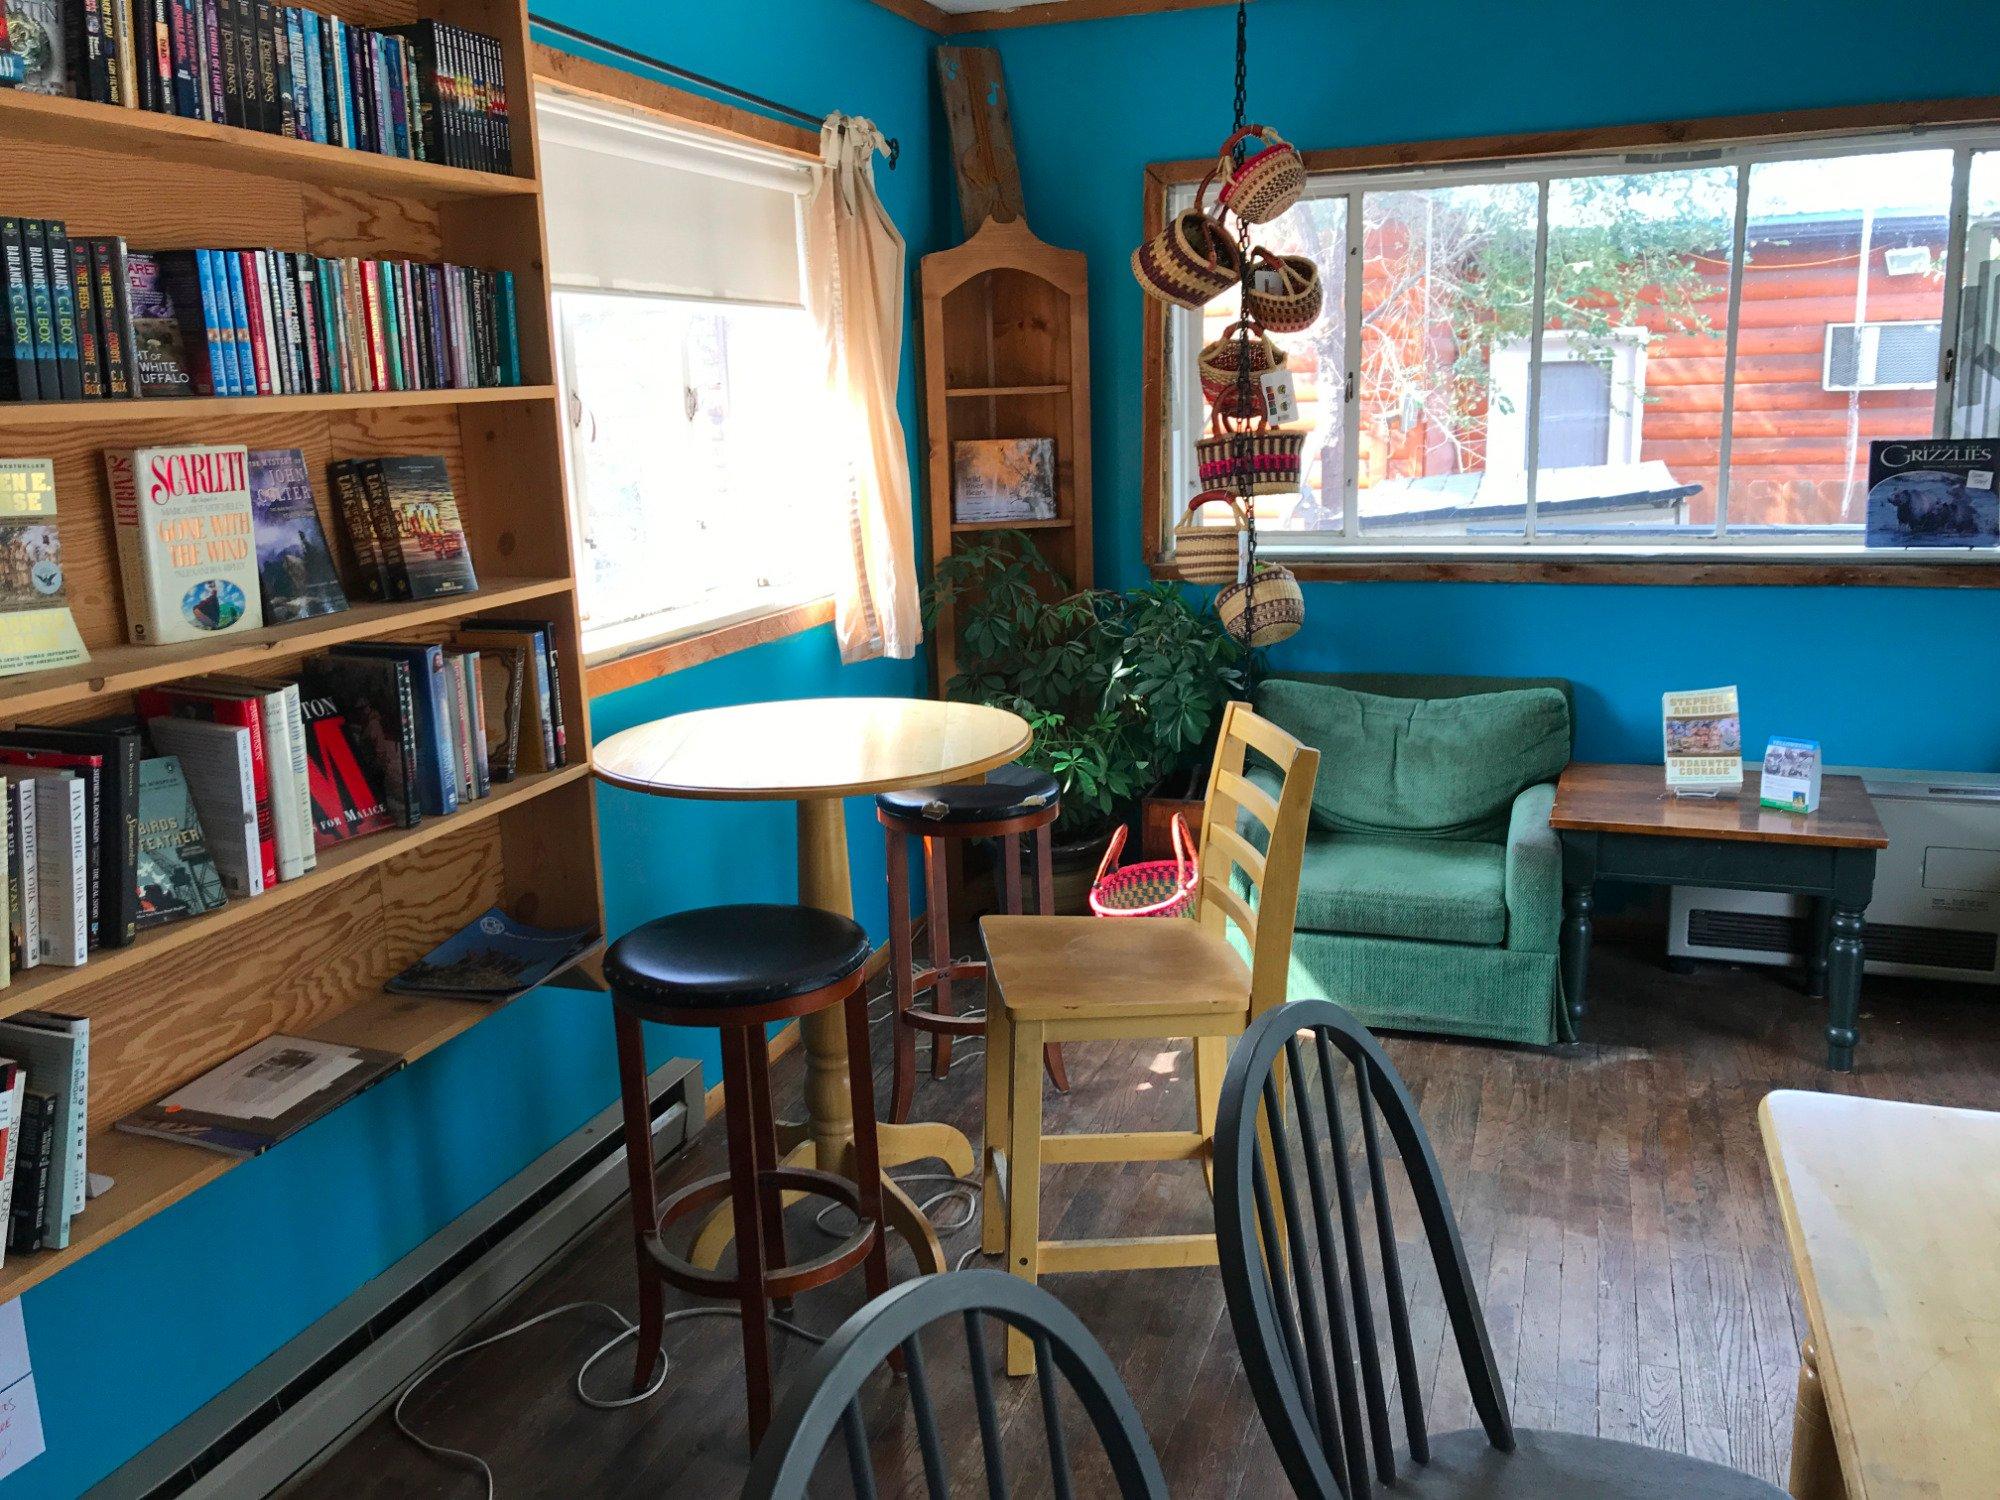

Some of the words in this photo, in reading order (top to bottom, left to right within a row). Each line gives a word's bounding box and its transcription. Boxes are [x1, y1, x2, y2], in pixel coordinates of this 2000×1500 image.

[6, 245, 23, 291] BADLANDS
[15, 317, 30, 344] BOX
[29, 246, 46, 290] BADLANDS
[38, 317, 52, 344] BOX
[51, 247, 69, 291] BADLANDS
[61, 318, 75, 344] BOX
[77, 286, 90, 310] WEEKS
[102, 285, 114, 308] WEEKS
[83, 333, 95, 366] GOODBYE
[107, 332, 121, 364] GOODBYE
[139, 362, 178, 372] WHITE
[140, 373, 190, 384] UFFALO
[1880, 444, 1992, 467] GRIZZLIES
[150, 451, 246, 506] SCARLETT
[268, 467, 305, 488] JOHN
[157, 515, 208, 543] GONE
[210, 511, 251, 538] WITH
[169, 542, 204, 568] THE
[206, 538, 249, 563] WIND
[1673, 704, 1730, 715] AMBROSE
[252, 723, 263, 761] EMERSON
[292, 745, 307, 774] HARD
[1670, 759, 1738, 768] UNDAUNTED
[1679, 767, 1730, 776] COURAGE
[22, 788, 33, 821] IVAN
[71, 788, 83, 821] IVAN
[320, 816, 342, 830] FOR
[344, 804, 387, 822] MALICE
[7, 833, 15, 857] BUS
[23, 825, 35, 858] DOIG
[73, 825, 84, 859] DOIG
[138, 829, 201, 851] FEATHER
[9, 876, 18, 913] IVAN
[26, 864, 38, 903] WORK
[75, 865, 85, 903] WORK
[28, 907, 39, 942] SONG
[77, 907, 86, 942] SONG
